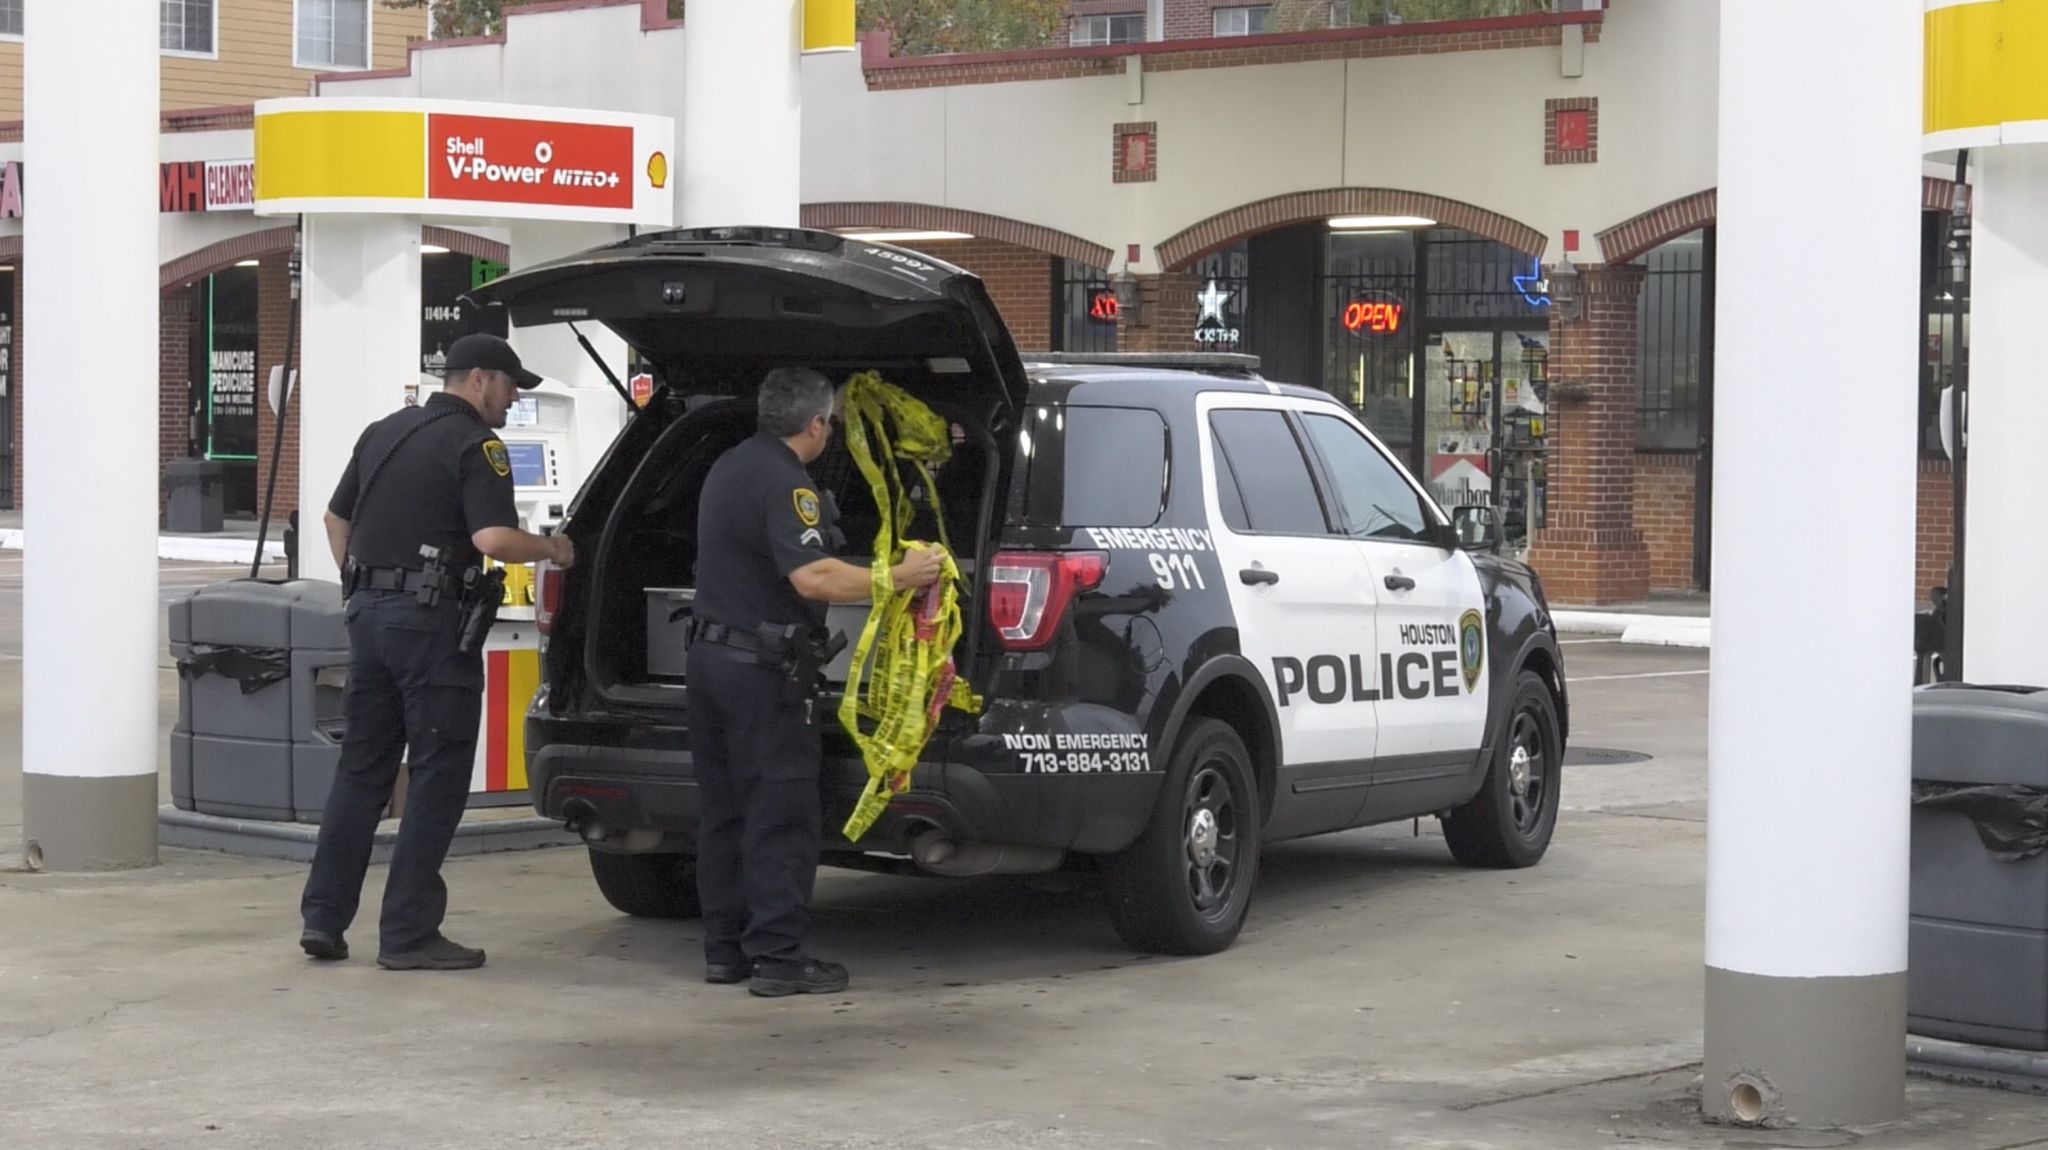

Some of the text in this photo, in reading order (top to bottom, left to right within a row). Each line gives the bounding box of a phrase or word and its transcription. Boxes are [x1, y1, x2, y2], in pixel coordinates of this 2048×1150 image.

[446, 137, 484, 156] Shell
[446, 155, 545, 184] V-Power
[424, 306, 461, 321] 11414-C
[1345, 303, 1400, 330] OPEN
[211, 350, 255, 371] MANICURE
[211, 372, 255, 393] PEDICURE
[1086, 527, 1214, 551] EMERGENCY
[1148, 552, 1206, 590] 911
[1400, 624, 1456, 645] HOUSTON
[1272, 651, 1459, 708] POLICE
[1002, 733, 1148, 750] NON EMERGENCY
[1019, 751, 1151, 773] 713-884-3131
